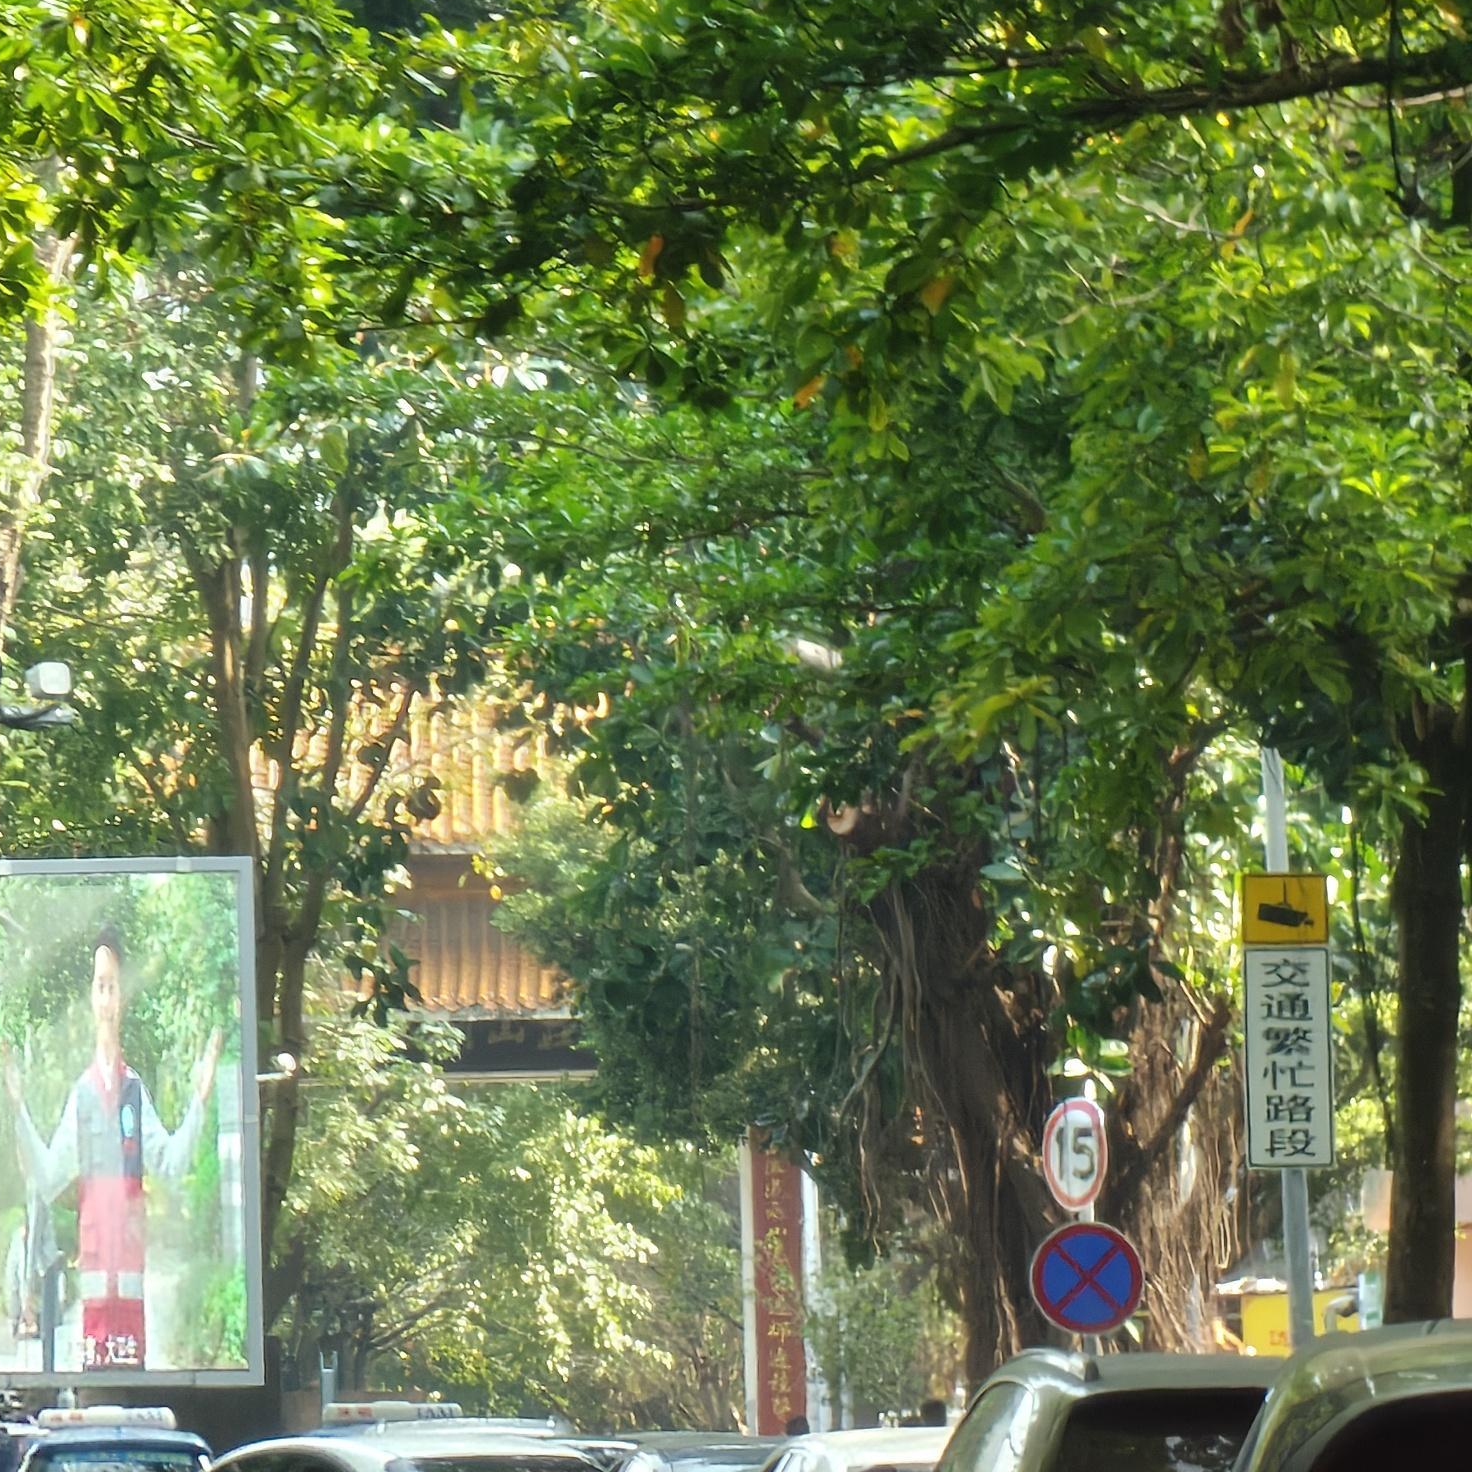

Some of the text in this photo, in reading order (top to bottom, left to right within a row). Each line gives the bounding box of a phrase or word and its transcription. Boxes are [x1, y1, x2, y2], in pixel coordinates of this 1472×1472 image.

[1260, 958, 1316, 1159] 交通繁忙路段
[1054, 1127, 1096, 1180] 15
